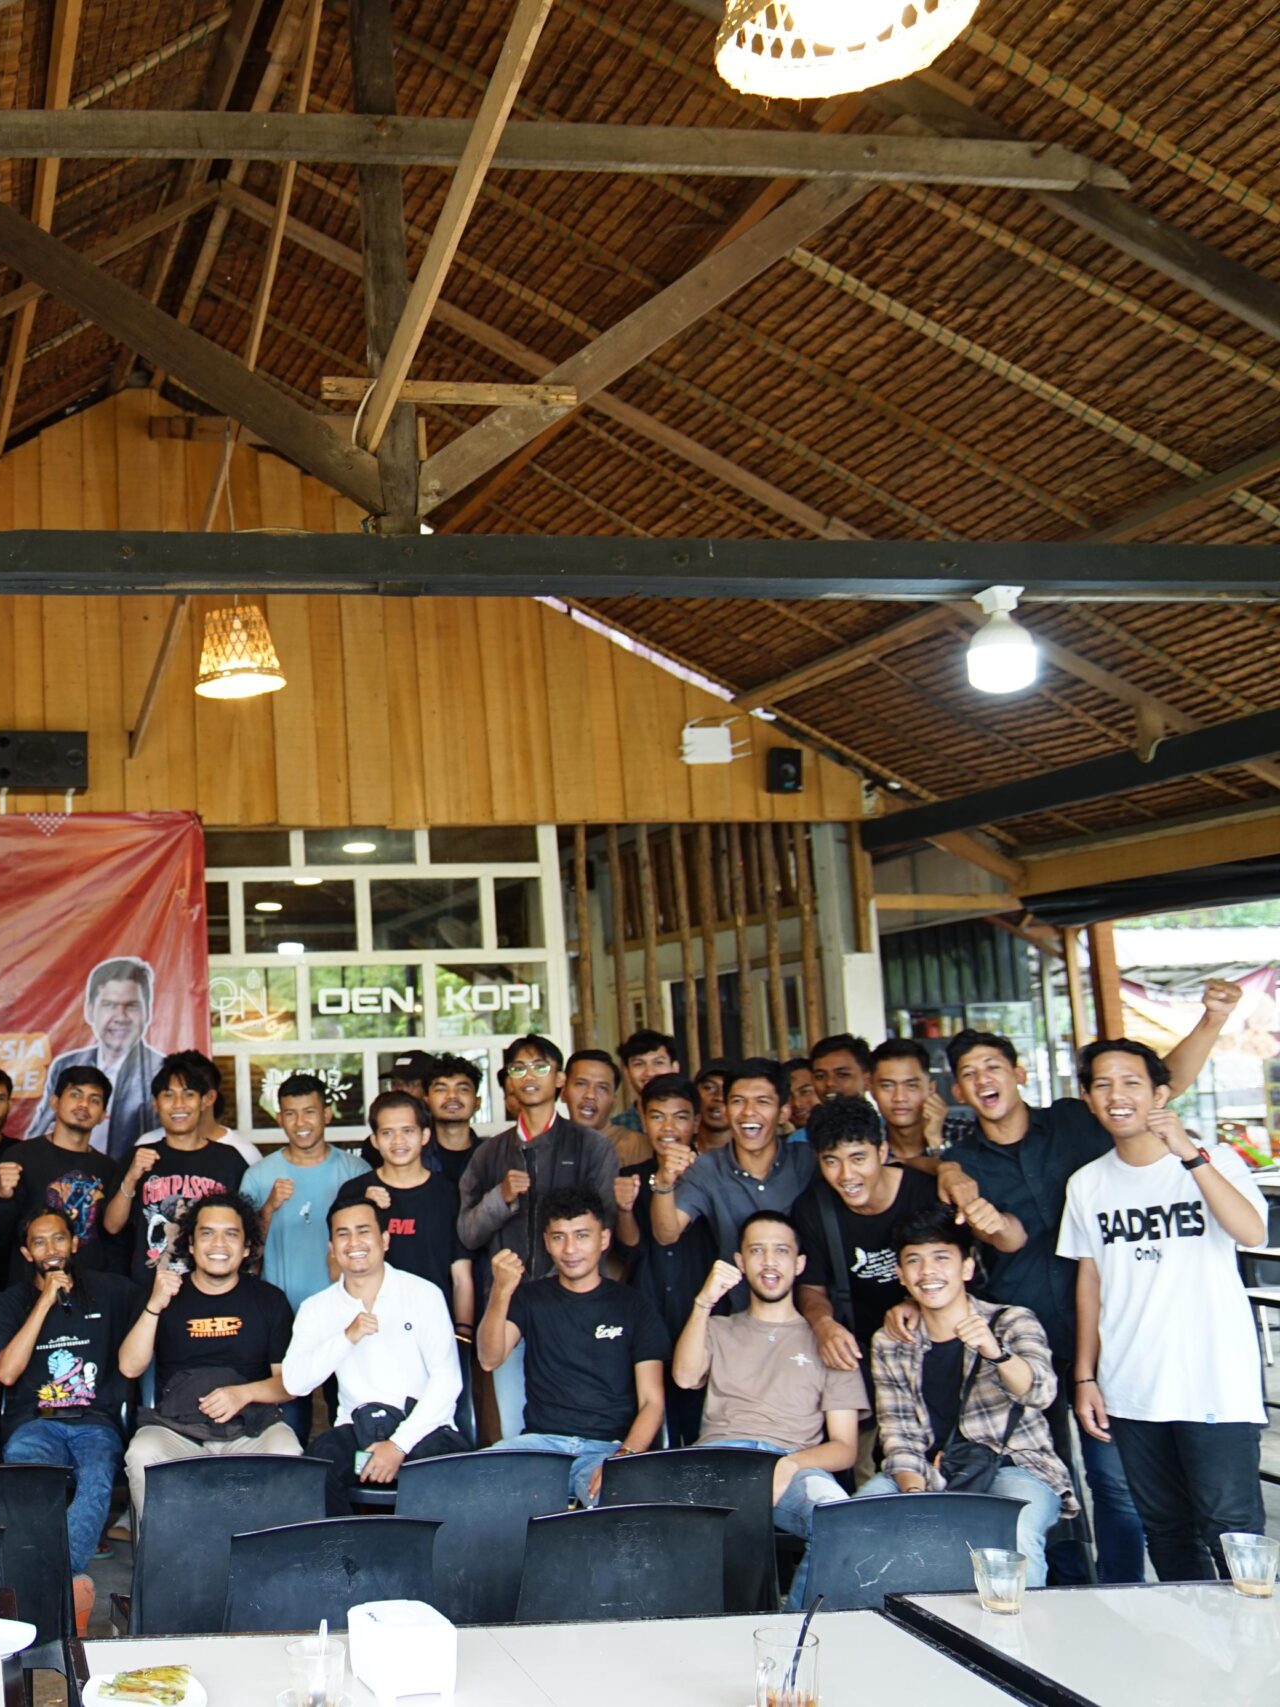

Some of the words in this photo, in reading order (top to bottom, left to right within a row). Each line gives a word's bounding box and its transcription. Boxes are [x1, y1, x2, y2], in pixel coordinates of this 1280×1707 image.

[318, 986, 414, 1015] OEN
[445, 983, 540, 1012] KOPI
[142, 1174, 227, 1205] COMPASS
[387, 1218, 417, 1235] EVIL
[1097, 1200, 1205, 1245] BADEYES
